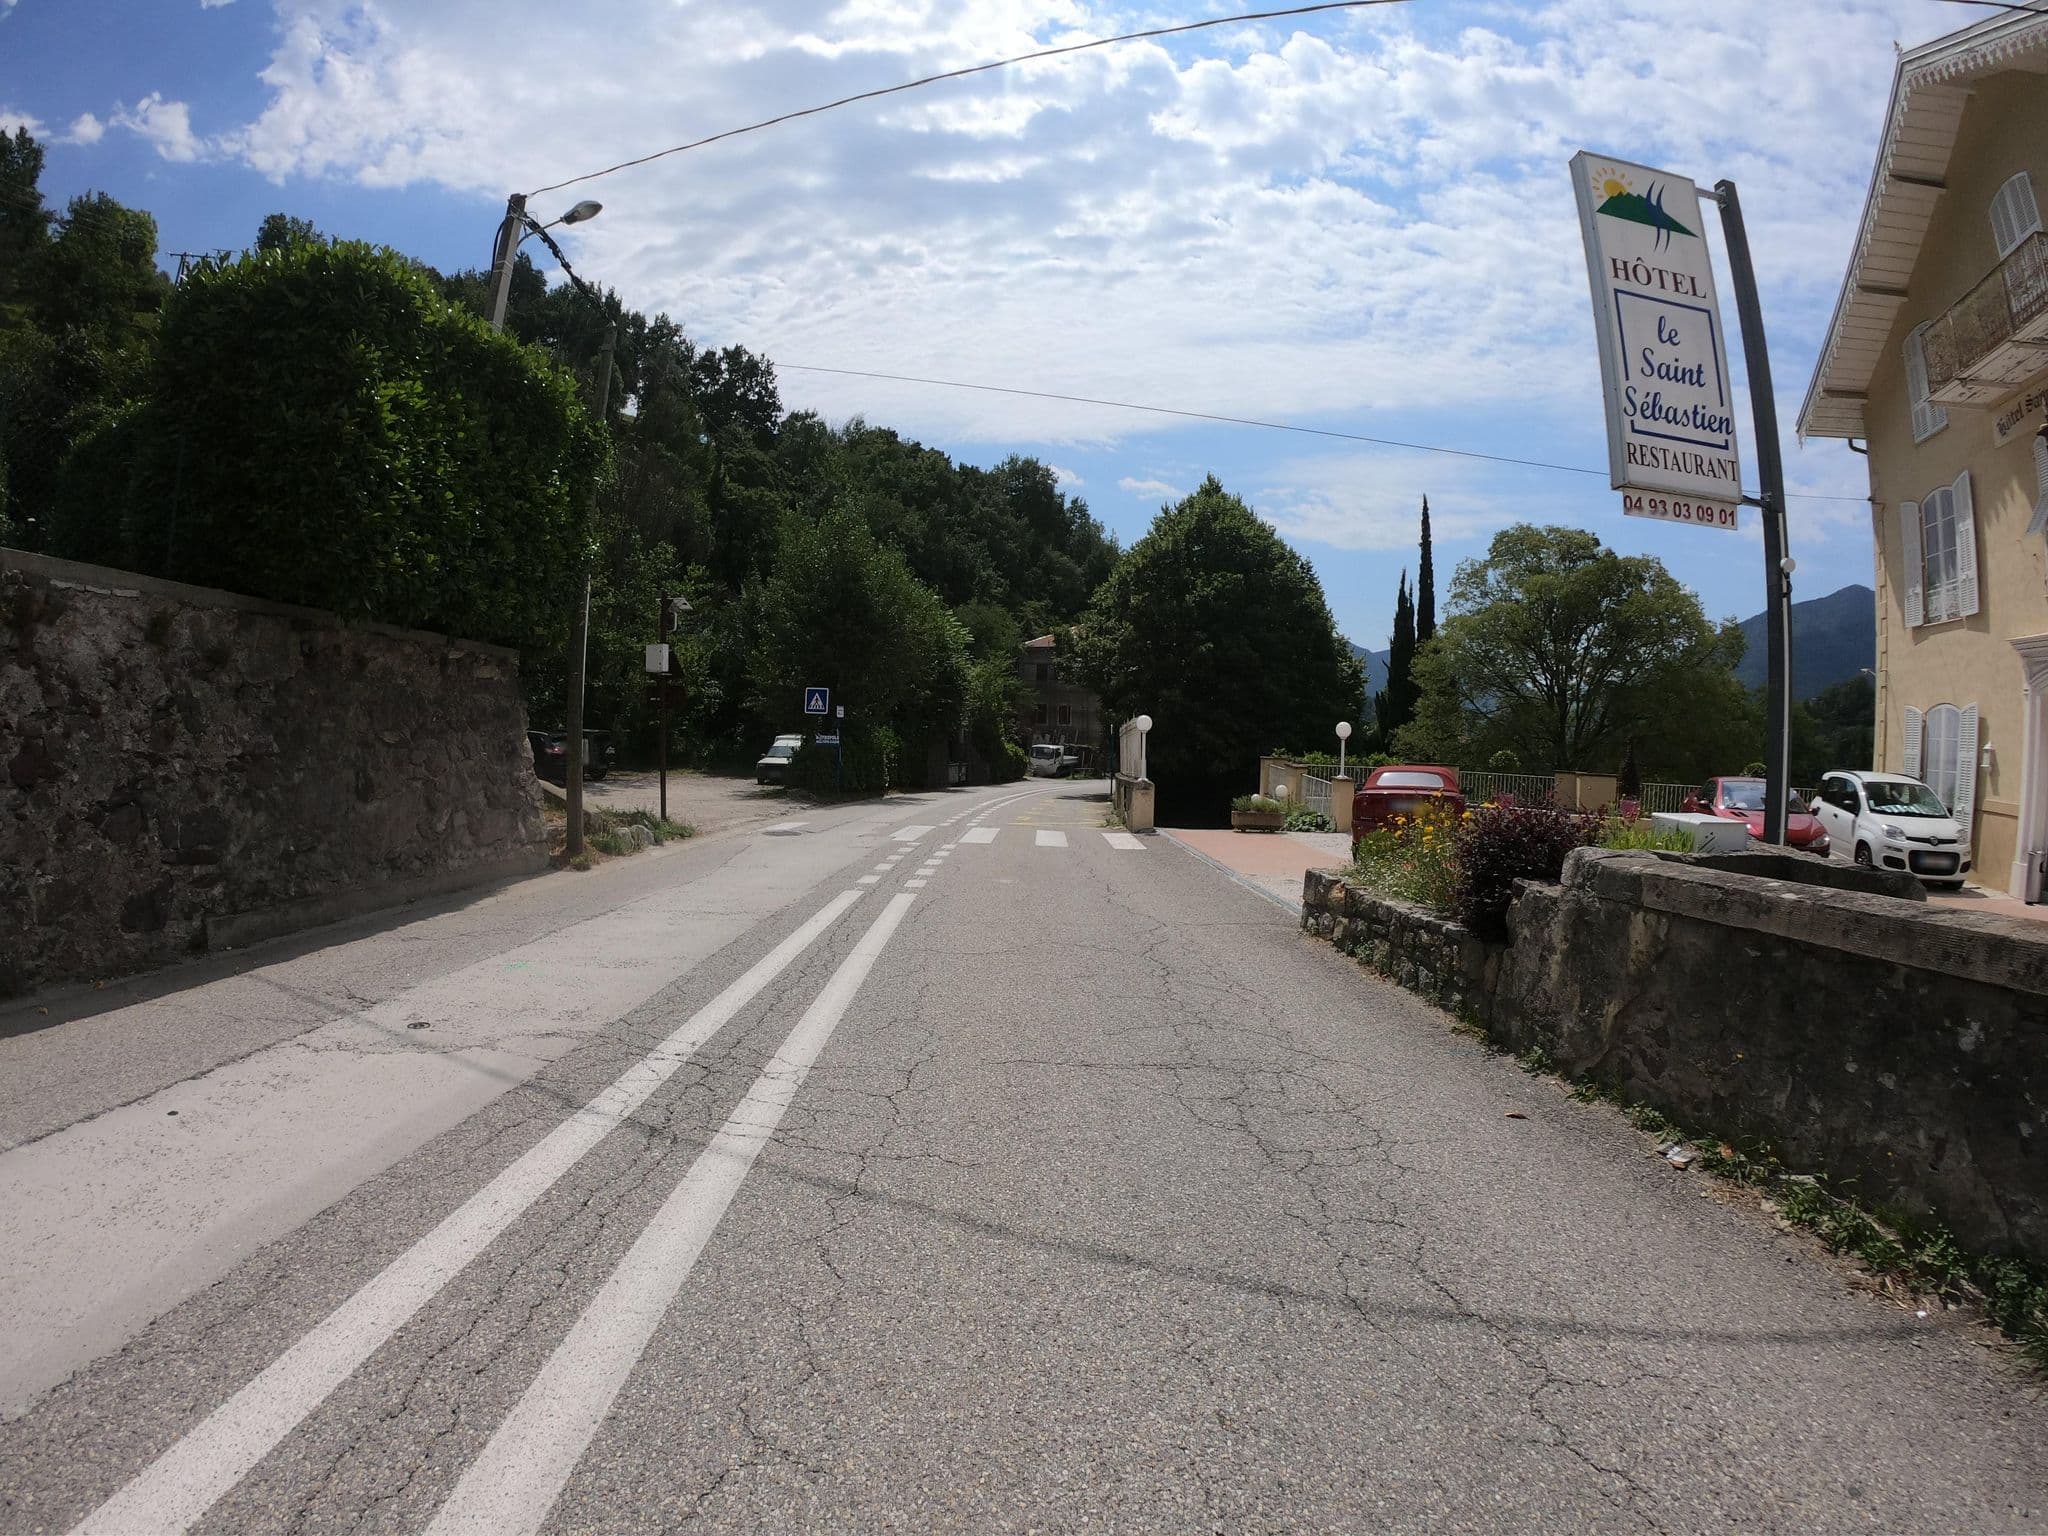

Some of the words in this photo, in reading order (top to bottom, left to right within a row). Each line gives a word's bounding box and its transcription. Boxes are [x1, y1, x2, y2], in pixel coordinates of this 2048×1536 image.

[1610, 257, 1707, 299] HÔTEL
[1657, 315, 1681, 346] le
[1640, 347, 1706, 387] Saint
[1623, 385, 1733, 435] Sébastien
[1626, 441, 1737, 481] RESTAURANT
[1623, 495, 1643, 511] 04
[1648, 498, 1668, 515] 93
[1673, 501, 1691, 519] 03
[1696, 505, 1714, 522] 09
[1719, 508, 1735, 526] 01
